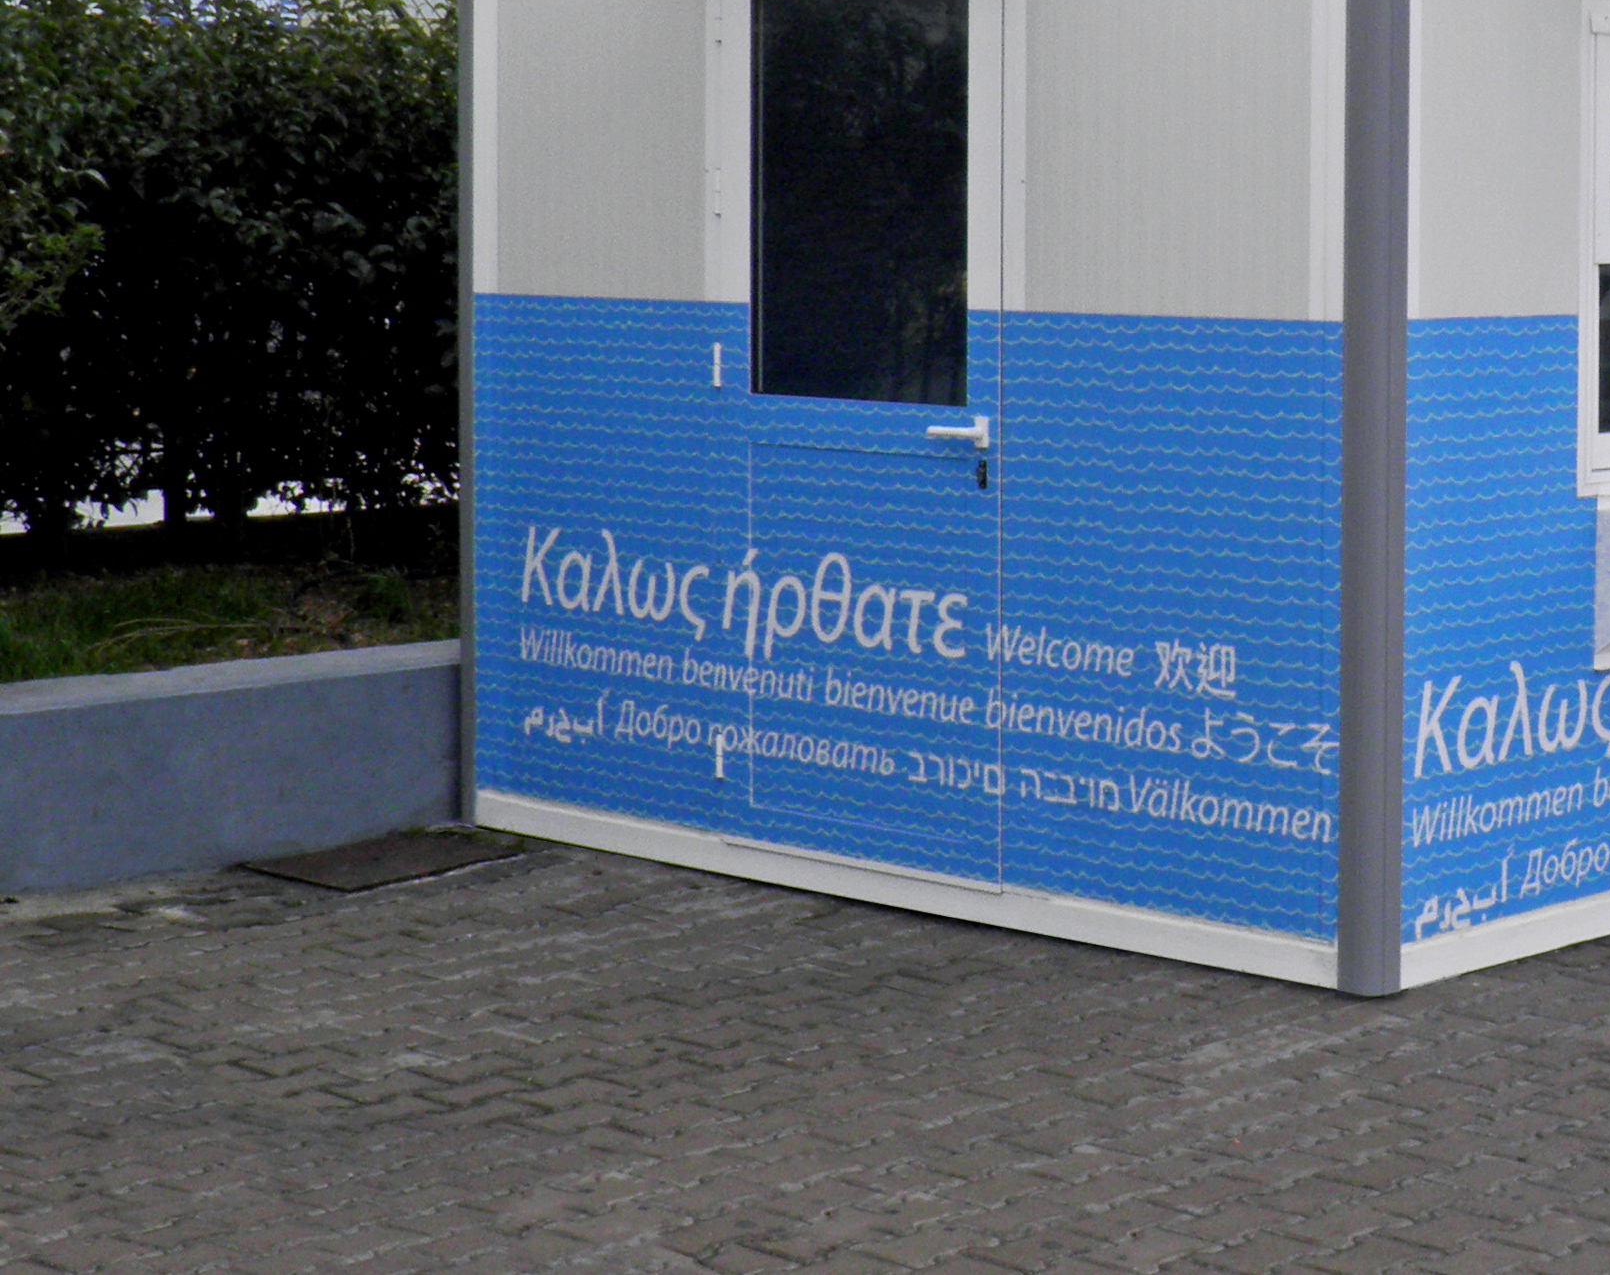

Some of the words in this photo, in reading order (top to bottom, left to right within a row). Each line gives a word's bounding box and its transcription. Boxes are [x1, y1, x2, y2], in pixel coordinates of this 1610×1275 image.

[721, 547, 968, 660] ήρθατε
[986, 623, 1135, 677] Welcome
[520, 626, 673, 681] Willkommen
[682, 648, 815, 702] benvenuti
[825, 668, 975, 726] bienvenue
[986, 688, 1182, 752] bienvenidos
[614, 700, 700, 750] Добро
[708, 723, 896, 777] пожаловать
[1191, 707, 1340, 776] ようこそ
[1130, 775, 1332, 844] Välkommen
[1411, 782, 1583, 848] Willkommen
[1519, 838, 1610, 899] Добро
